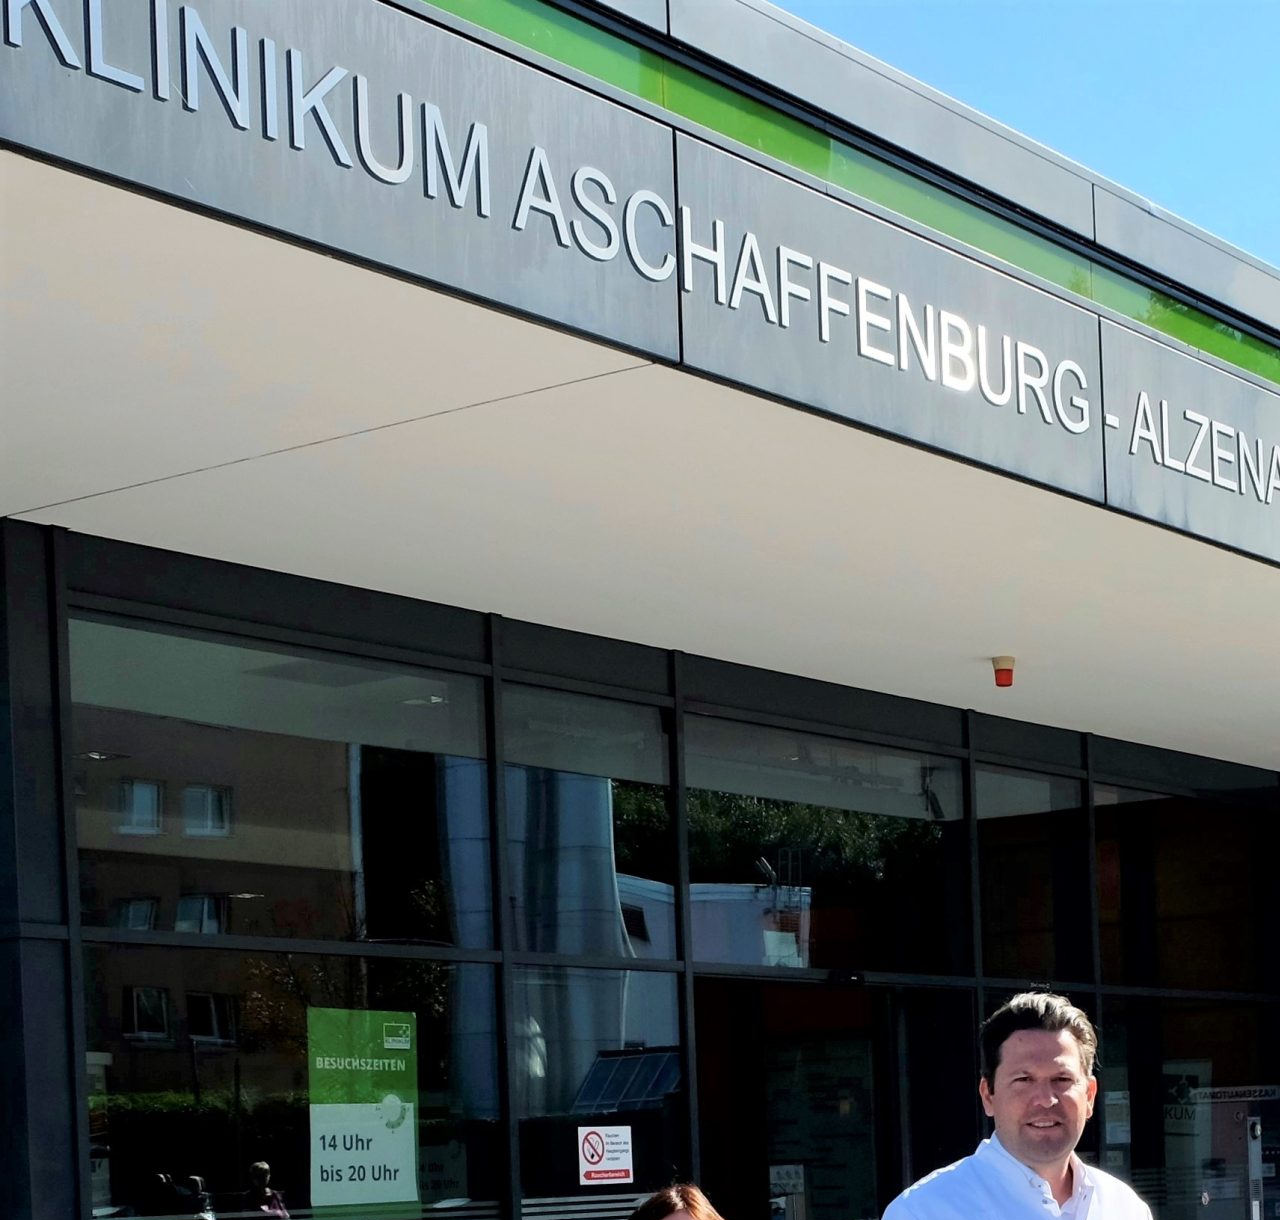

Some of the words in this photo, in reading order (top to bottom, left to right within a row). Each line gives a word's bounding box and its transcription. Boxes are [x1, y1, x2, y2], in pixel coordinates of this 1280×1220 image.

[513, 146, 1090, 435] ASCHAFFENBURG
[316, 1057, 405, 1072] BESUCHSZEITEN
[319, 1134, 338, 1151] 14
[342, 1133, 373, 1151] Uhr
[320, 1165, 343, 1182] bis
[348, 1165, 366, 1181] 20
[371, 1164, 400, 1181] Uhr
